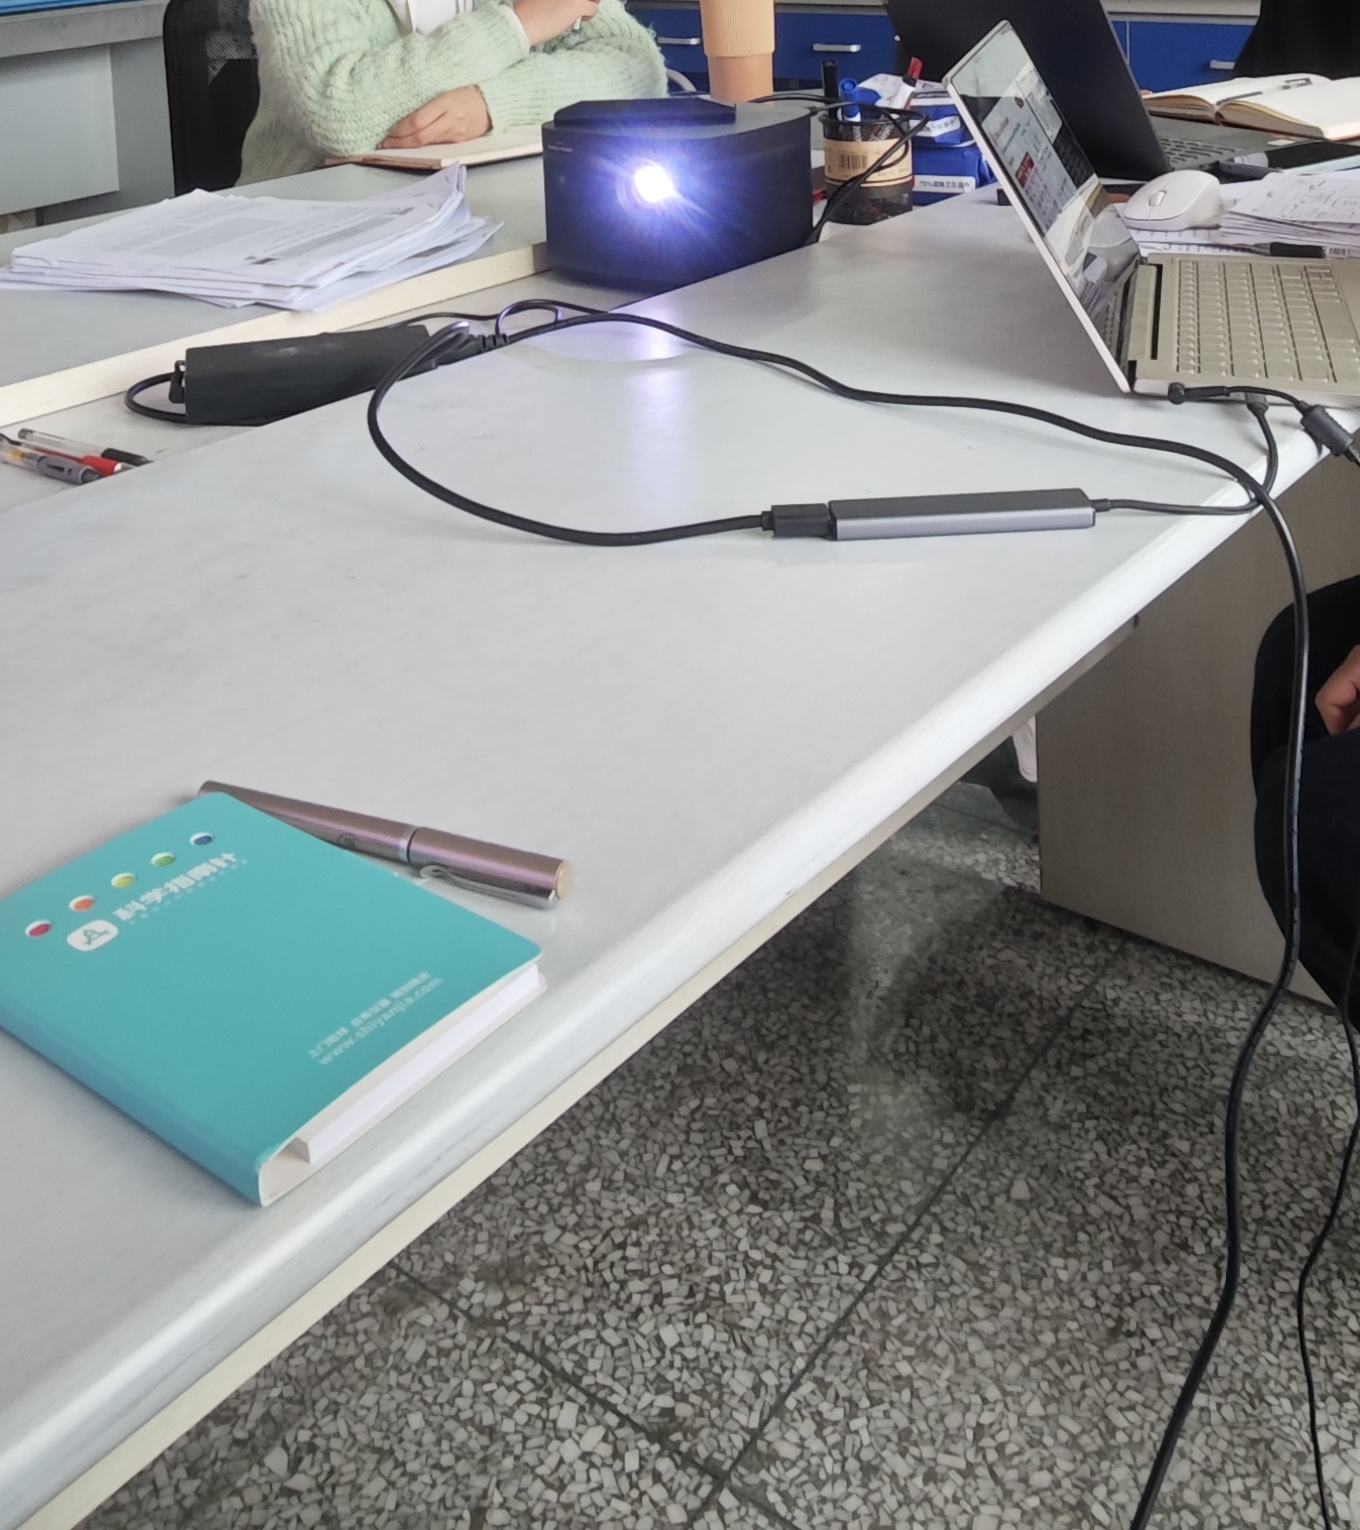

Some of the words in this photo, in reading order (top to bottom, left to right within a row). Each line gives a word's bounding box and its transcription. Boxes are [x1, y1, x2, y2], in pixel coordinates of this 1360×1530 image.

[113, 852, 237, 921] 科学指南针
[319, 977, 443, 1065] www.shiyanjia.com
